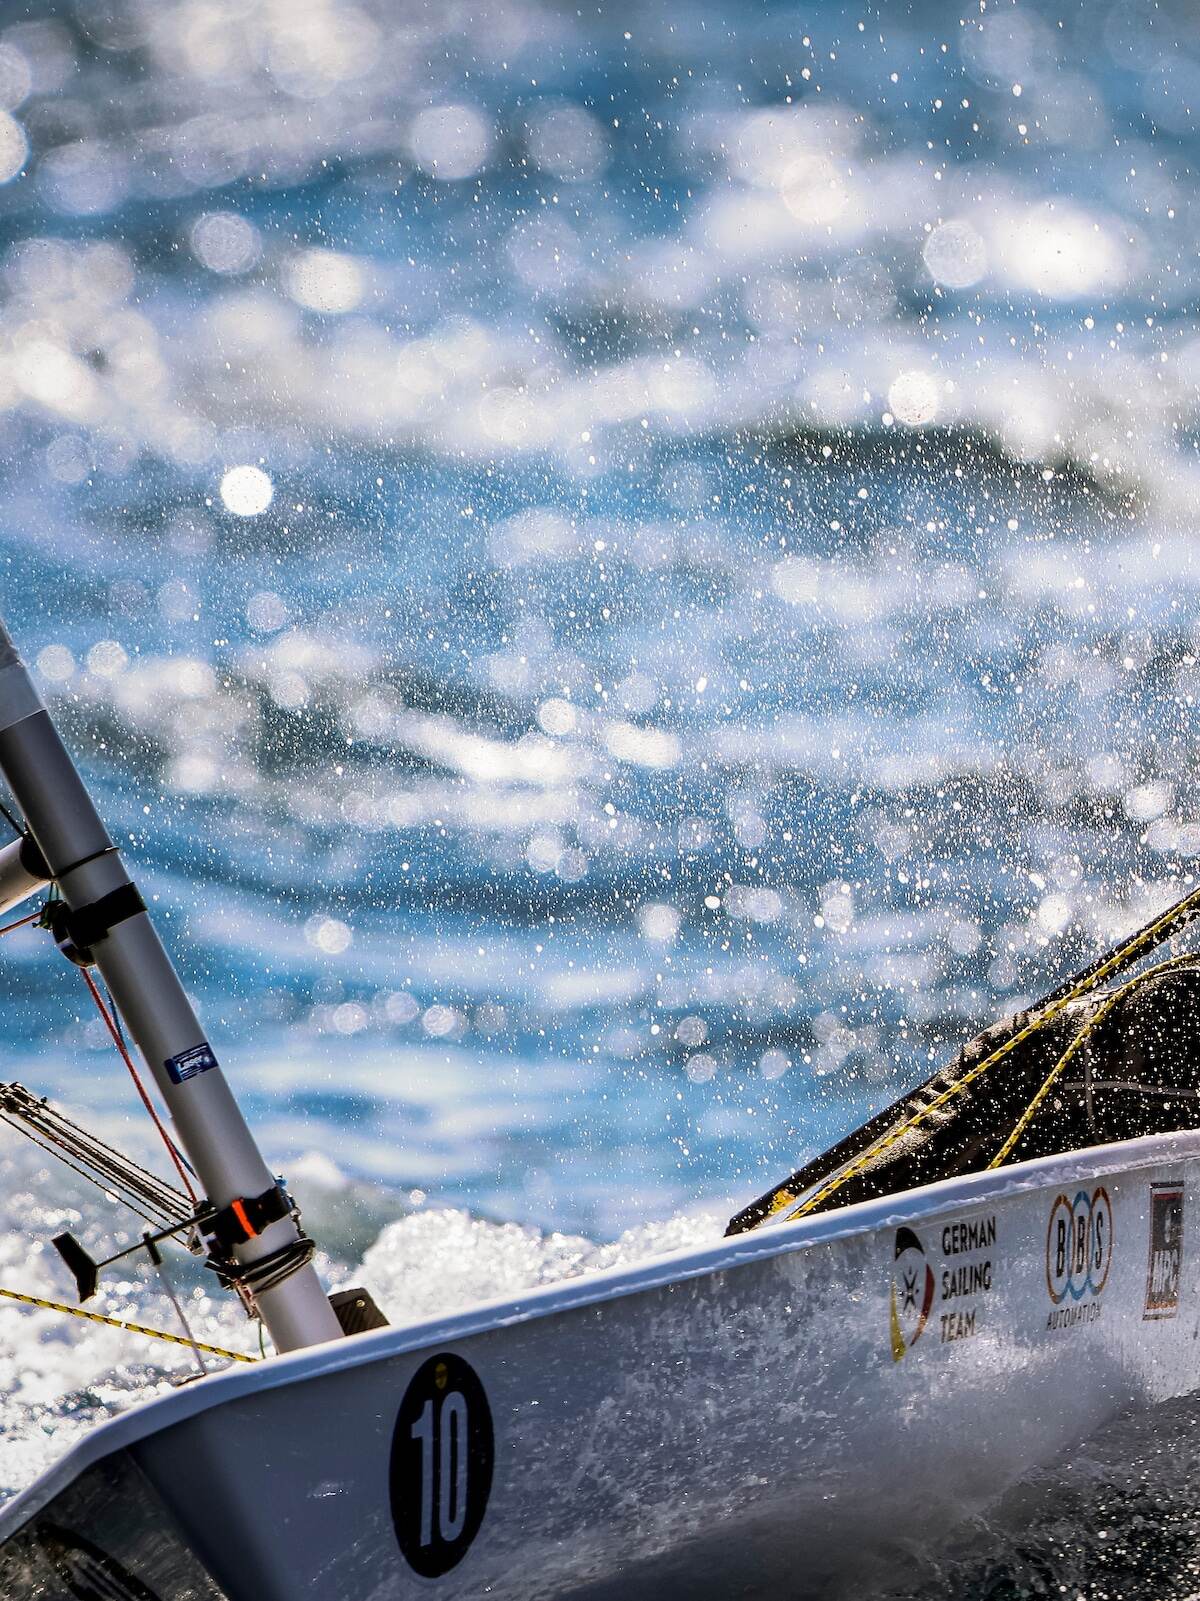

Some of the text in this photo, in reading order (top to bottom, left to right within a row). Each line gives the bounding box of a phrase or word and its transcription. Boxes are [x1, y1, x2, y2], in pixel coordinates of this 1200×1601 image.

[942, 1215, 997, 1256] GERMAN
[1056, 1211, 1104, 1278] BBS
[942, 1261, 992, 1300] SAILING
[940, 1308, 977, 1343] TEAM
[1047, 1301, 1102, 1331] AUTOMATION
[411, 1390, 468, 1547] 10
